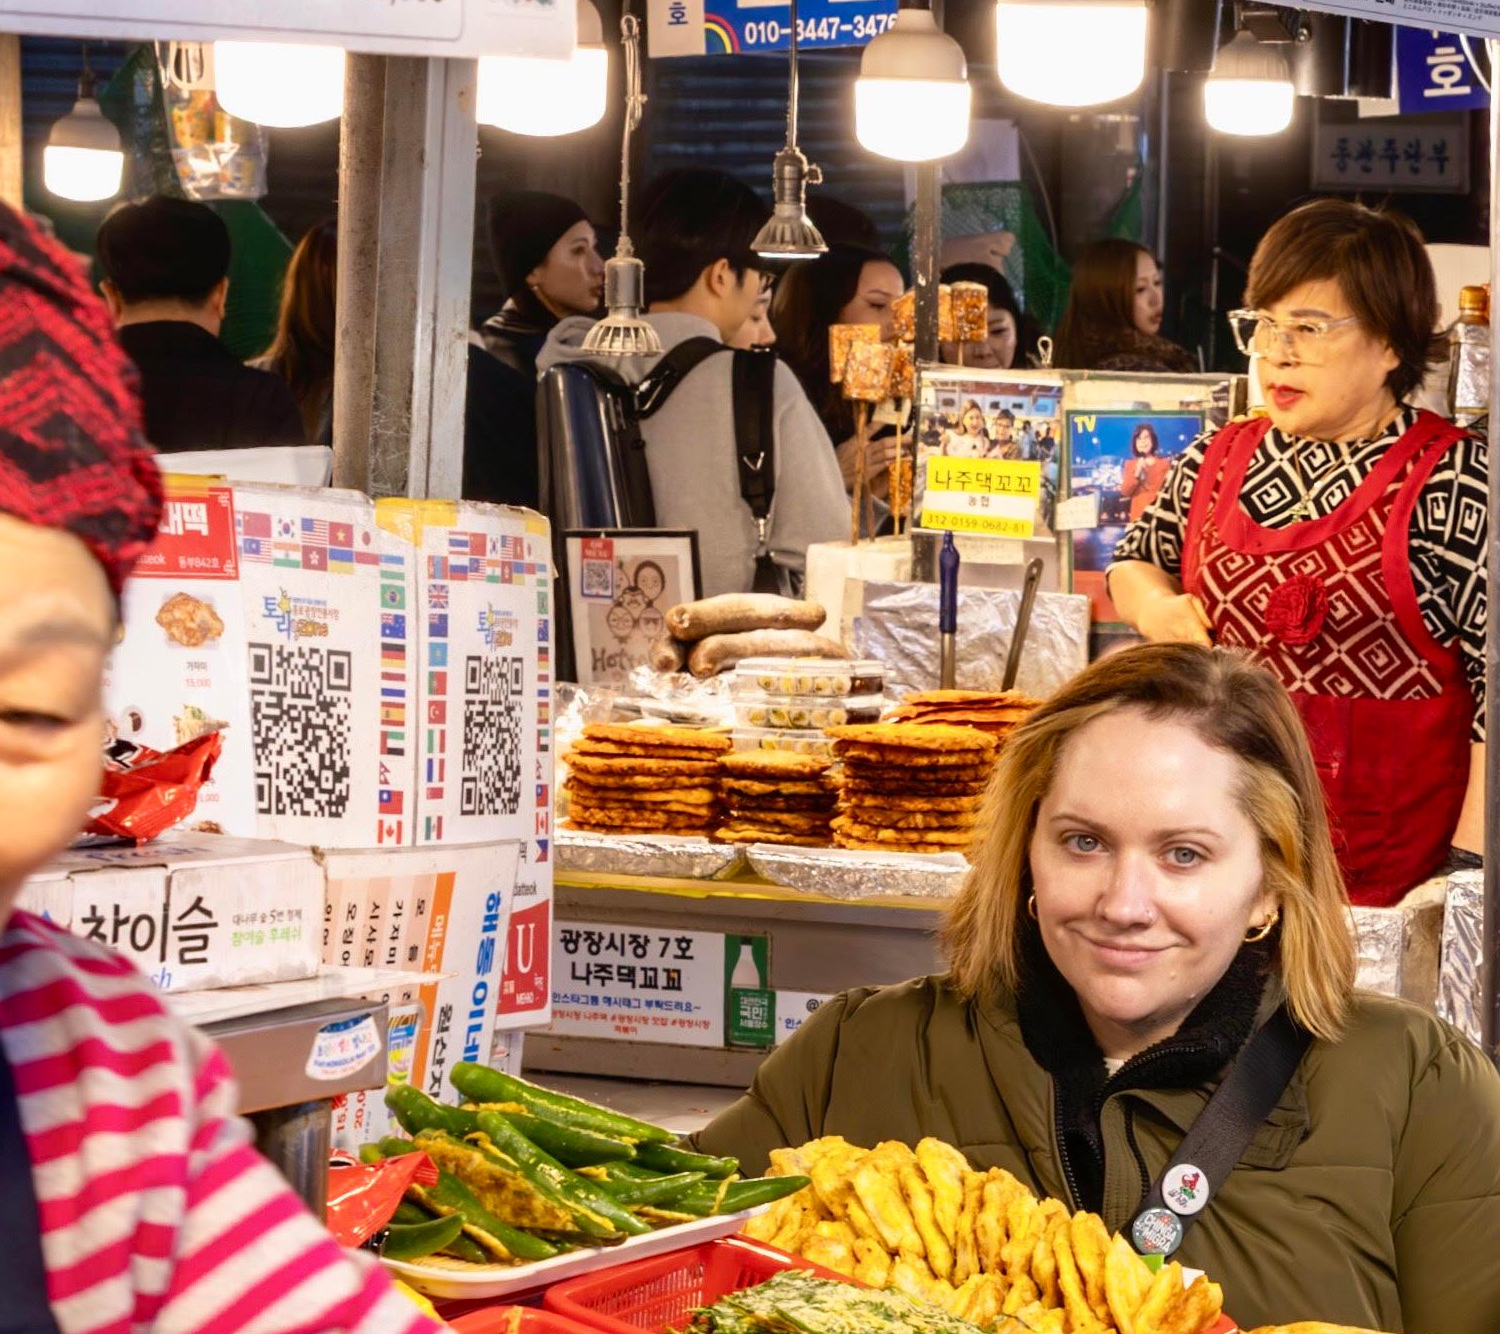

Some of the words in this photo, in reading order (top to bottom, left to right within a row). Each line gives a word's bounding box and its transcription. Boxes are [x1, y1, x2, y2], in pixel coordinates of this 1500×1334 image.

[667, 0, 689, 27] 호
[1074, 414, 1097, 435] TV
[934, 468, 1032, 494] 나주댁꼬꼬
[560, 928, 650, 960] 광장시장
[658, 935, 694, 960] 7호
